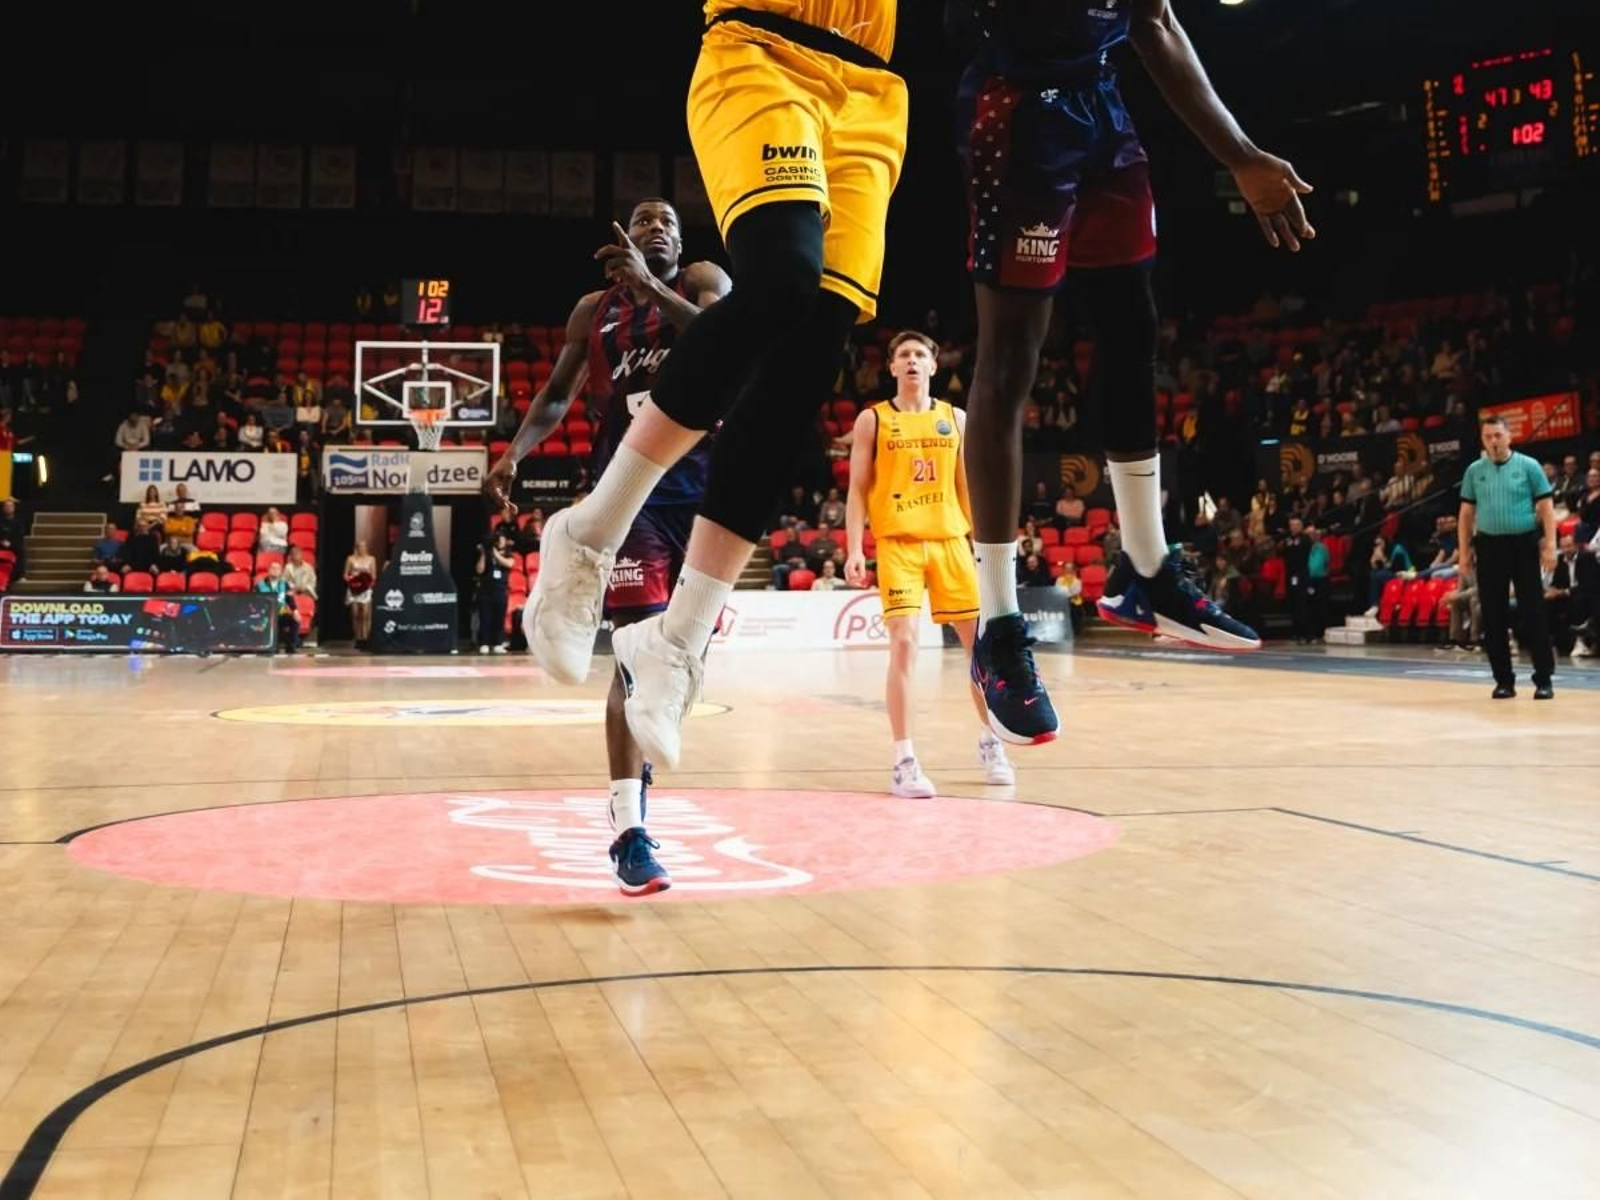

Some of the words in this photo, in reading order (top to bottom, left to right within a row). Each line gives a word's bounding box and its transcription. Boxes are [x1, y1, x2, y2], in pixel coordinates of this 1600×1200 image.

[1484, 86, 1508, 108] 47
[1529, 79, 1553, 100] 43
[761, 143, 817, 162] bwin
[765, 175, 821, 183] OOSTEN
[1016, 238, 1061, 256] KING
[887, 438, 955, 451] OOSTENDE
[168, 458, 255, 482] LAMO
[373, 464, 479, 488] Nodzee
[913, 459, 936, 482] 21
[522, 479, 557, 489] SCREW
[559, 479, 569, 489] IT
[611, 567, 644, 583] KING
[10, 602, 104, 614] DOWNLOAD
[10, 613, 41, 625] THE
[42, 613, 75, 625] APP
[77, 613, 132, 625] TODAY
